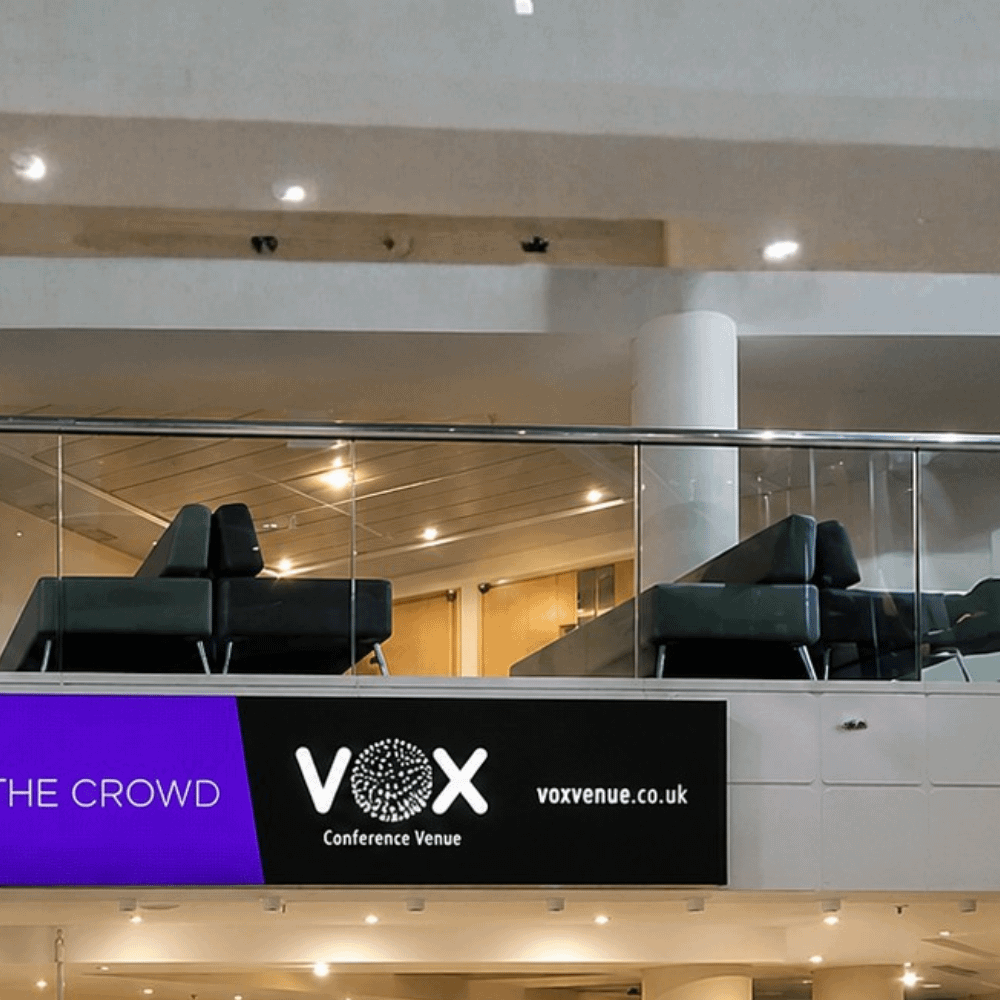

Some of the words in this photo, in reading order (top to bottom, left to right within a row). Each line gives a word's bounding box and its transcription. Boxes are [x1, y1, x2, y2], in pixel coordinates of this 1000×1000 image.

[71, 778, 221, 810] CROWD
[294, 738, 490, 823] VOX
[536, 782, 689, 806] voxvenue.co.uk
[322, 828, 409, 847] Conference
[414, 829, 463, 847] Venue
